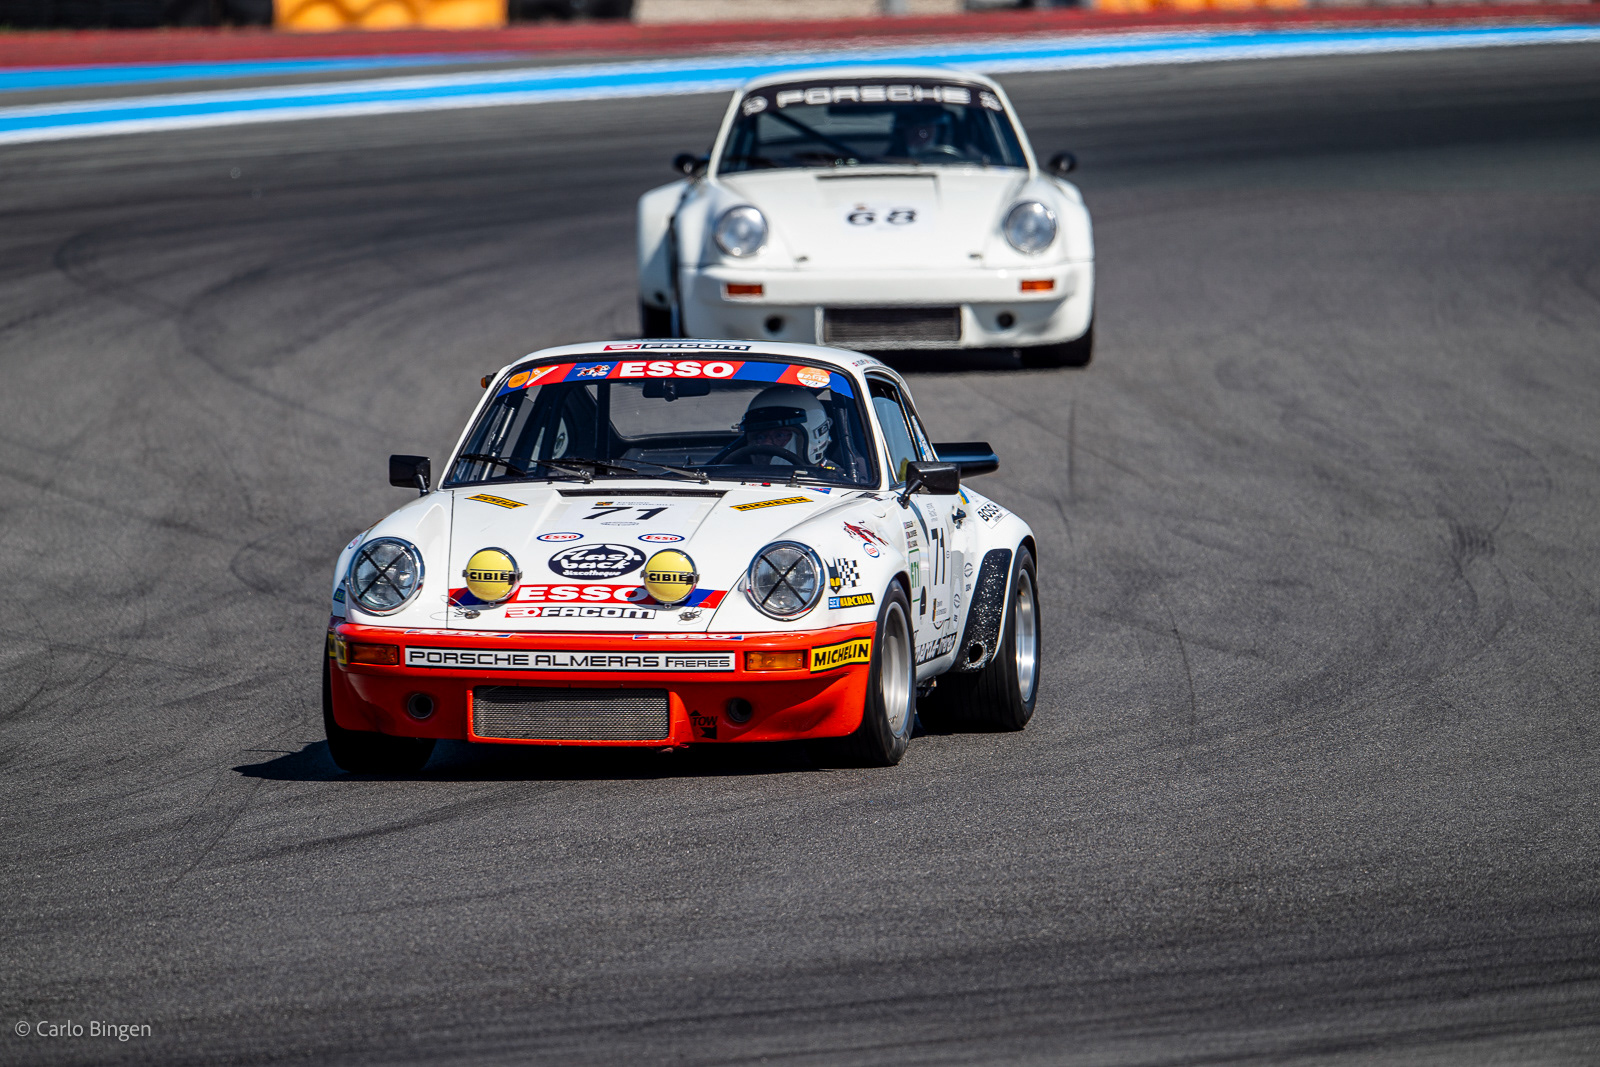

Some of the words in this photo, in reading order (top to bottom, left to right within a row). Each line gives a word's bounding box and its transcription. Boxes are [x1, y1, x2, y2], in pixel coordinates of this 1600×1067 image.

[776, 84, 971, 108] PORSCHE
[847, 209, 917, 227] 68
[619, 361, 734, 378] ESSO
[582, 506, 668, 521] 71
[930, 527, 945, 586] 71
[516, 586, 650, 602] ESSO
[540, 608, 655, 619] FACOM
[410, 651, 534, 666] PORSCHE
[535, 654, 659, 668] ALMERAS
[665, 656, 730, 668] FRERES
[814, 643, 869, 667] MICHELIN
[692, 716, 718, 726] TOW
